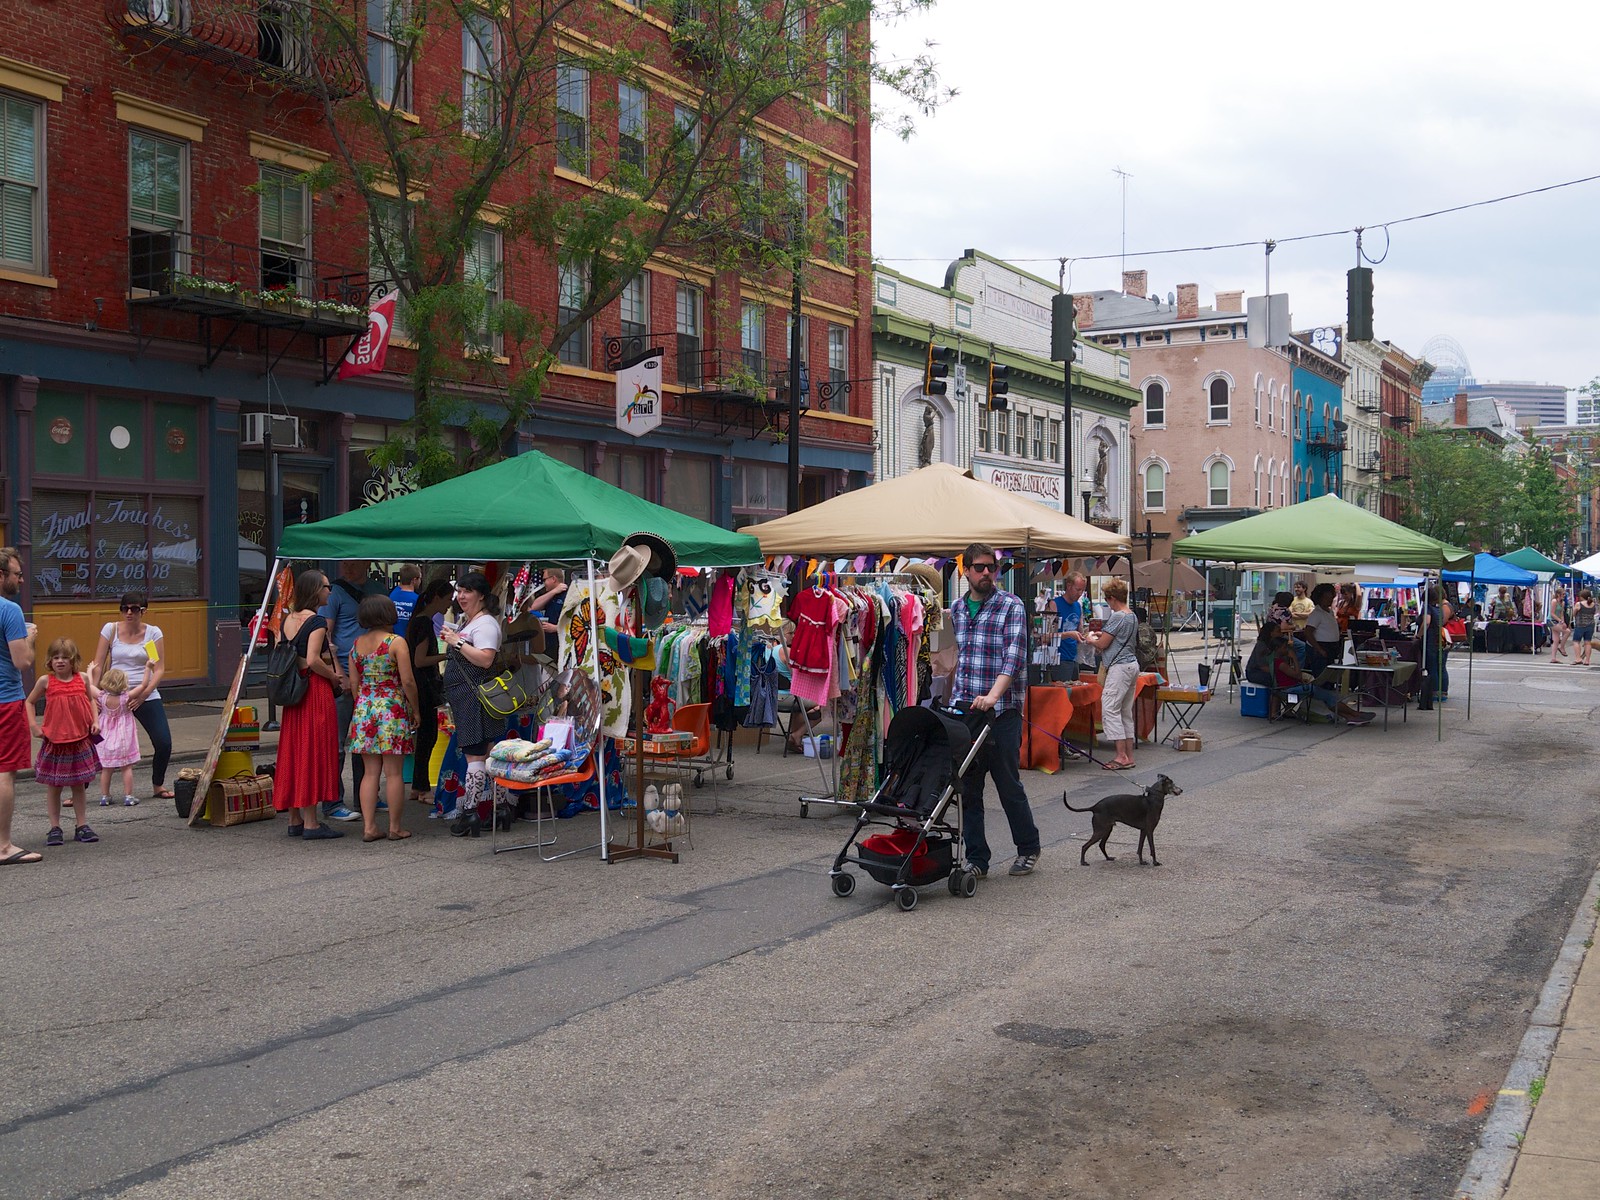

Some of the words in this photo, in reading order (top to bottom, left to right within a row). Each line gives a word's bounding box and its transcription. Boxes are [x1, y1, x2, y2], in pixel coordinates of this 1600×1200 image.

[956, 367, 965, 378] ONE
[956, 378, 964, 388] WAY
[634, 400, 653, 414] art
[1021, 473, 1060, 500] ANTIQUES
[44, 540, 90, 559] Hair
[95, 539, 109, 559] &
[112, 541, 148, 560] Nail
[77, 564, 170, 580] 579-0808
